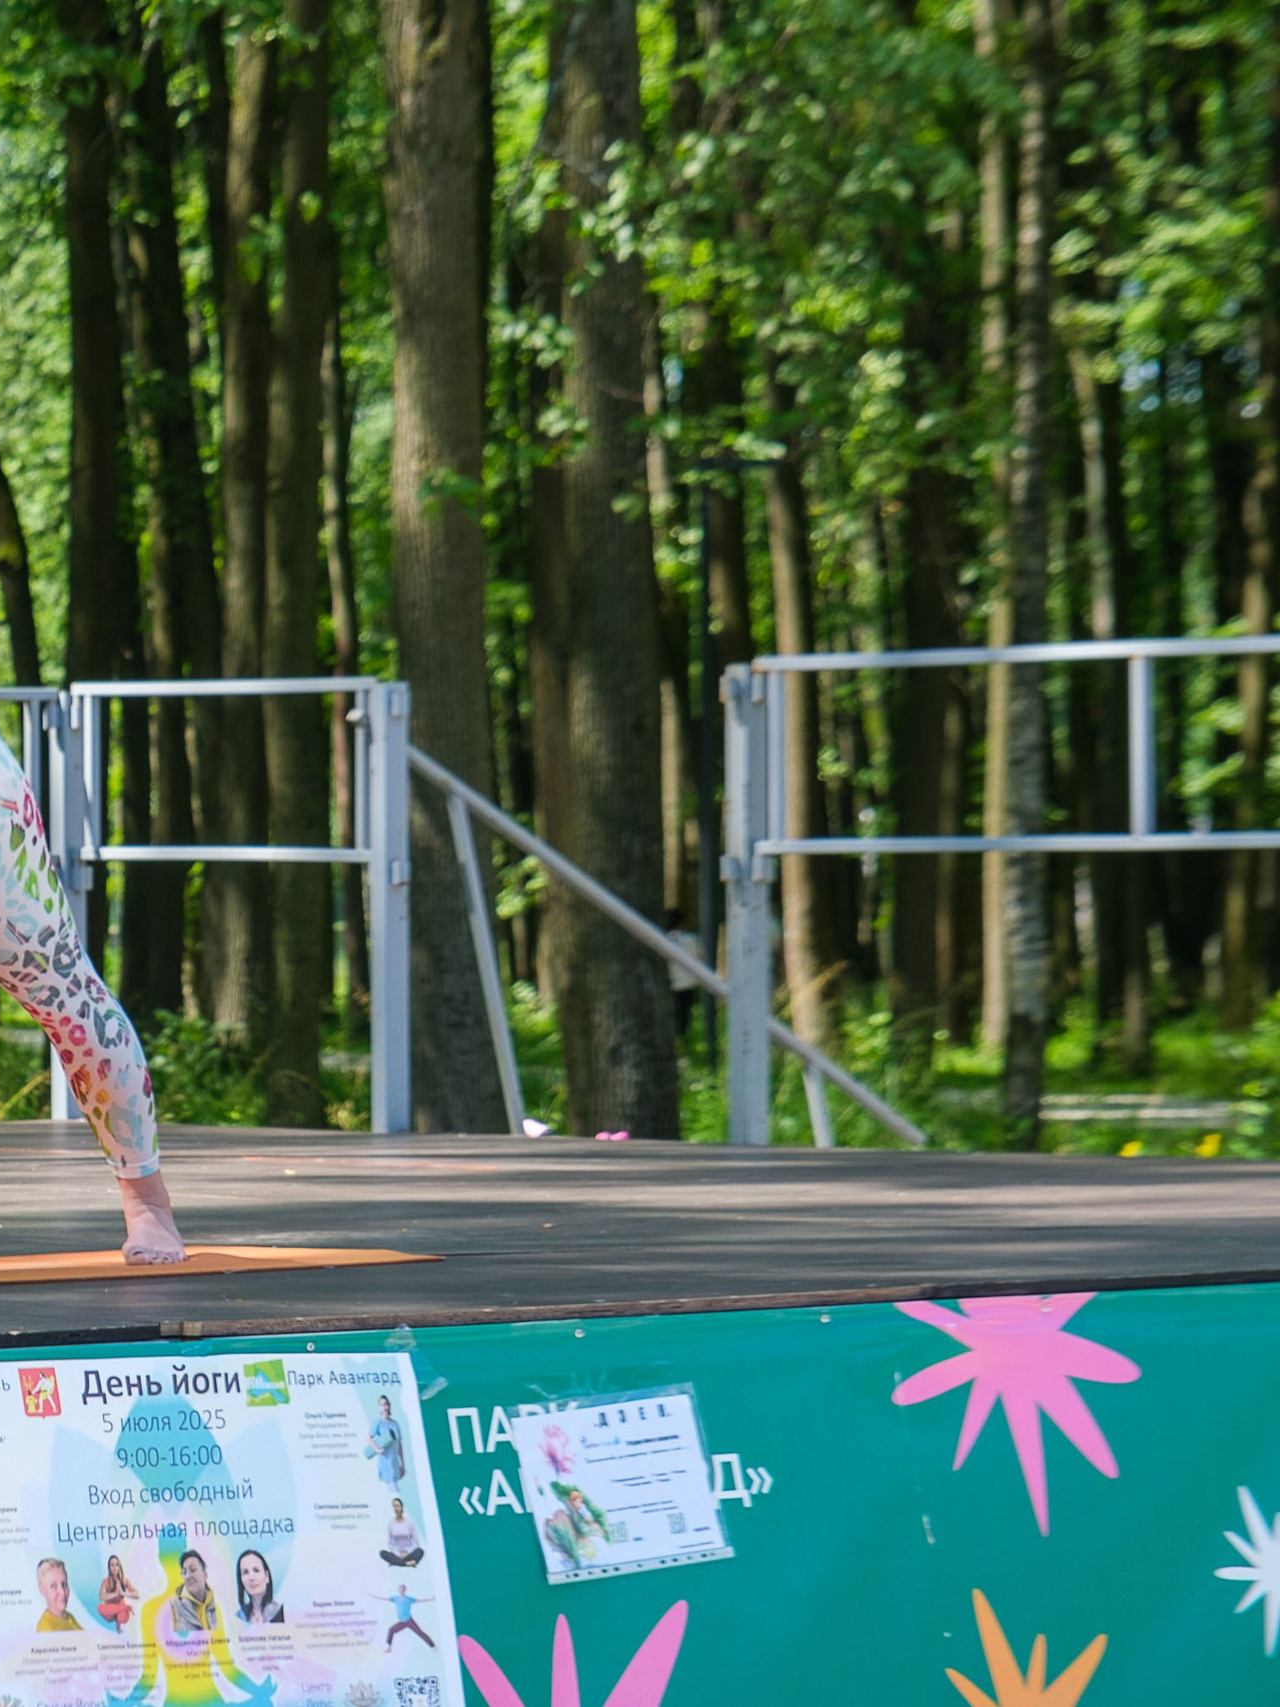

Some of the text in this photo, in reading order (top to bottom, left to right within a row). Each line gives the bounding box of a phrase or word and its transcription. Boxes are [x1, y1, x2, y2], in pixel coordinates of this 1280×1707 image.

[81, 1364, 241, 1406] День йоги
[287, 1370, 325, 1388] Парк
[329, 1370, 402, 1387] Авангард
[102, 1409, 227, 1433] 5 июля 2025
[117, 1445, 223, 1469] 9:00-16:00
[88, 1478, 253, 1508] Вход свободный
[57, 1516, 295, 1547] Центральная площадка
